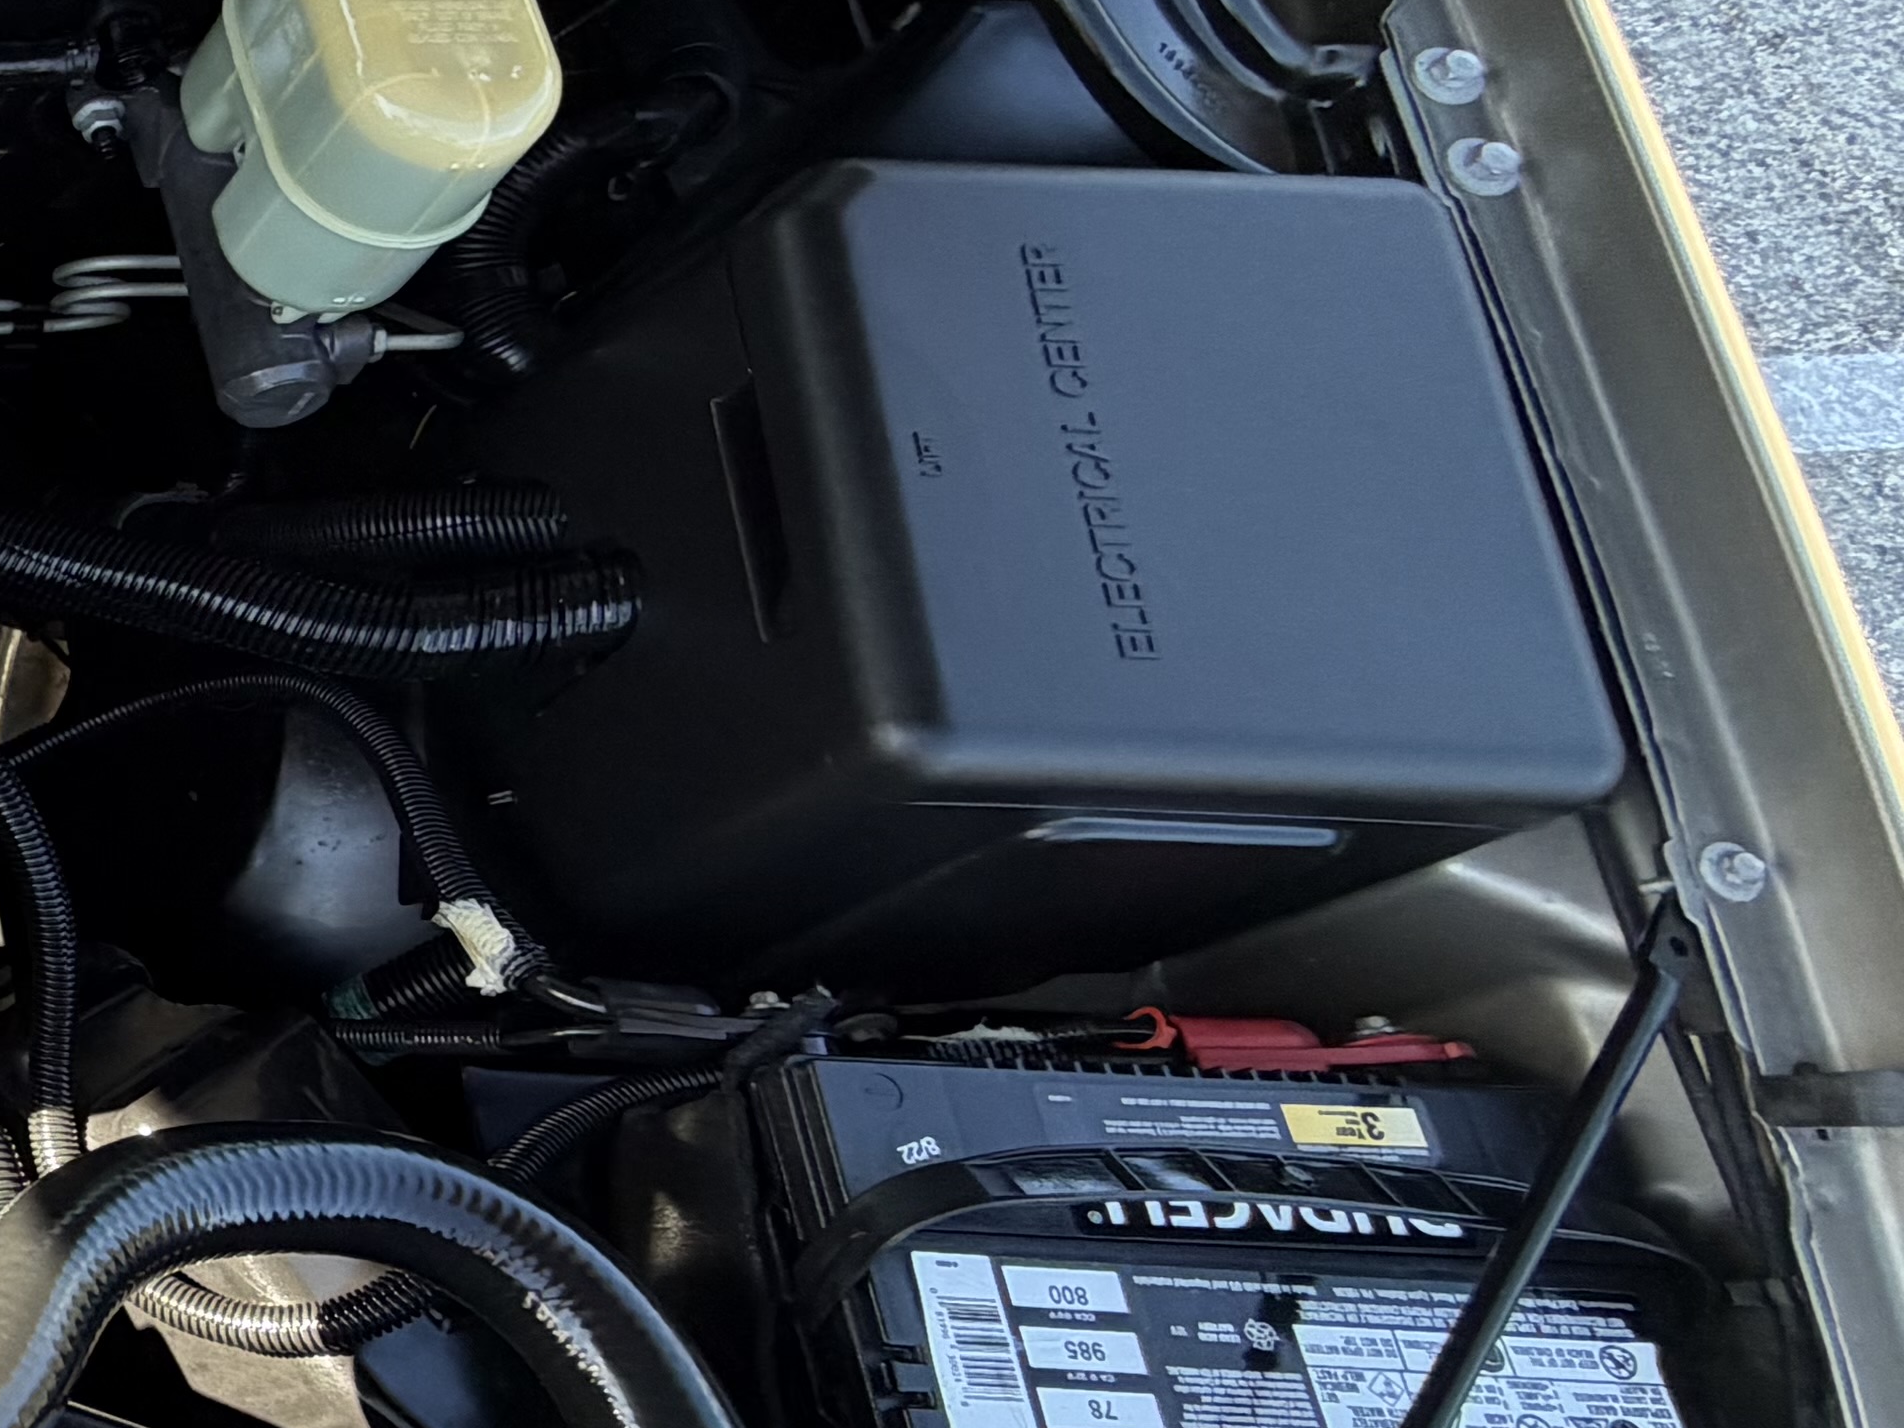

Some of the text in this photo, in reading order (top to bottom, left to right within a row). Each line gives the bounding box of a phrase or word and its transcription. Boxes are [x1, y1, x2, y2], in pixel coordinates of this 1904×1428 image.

[1017, 241, 1161, 663] ELECTRICAL CENTER
[1360, 1112, 1385, 1141] 3
[1048, 1284, 1089, 1306] 800
[1064, 1340, 1107, 1362] 985
[1088, 1399, 1119, 1421] 78
